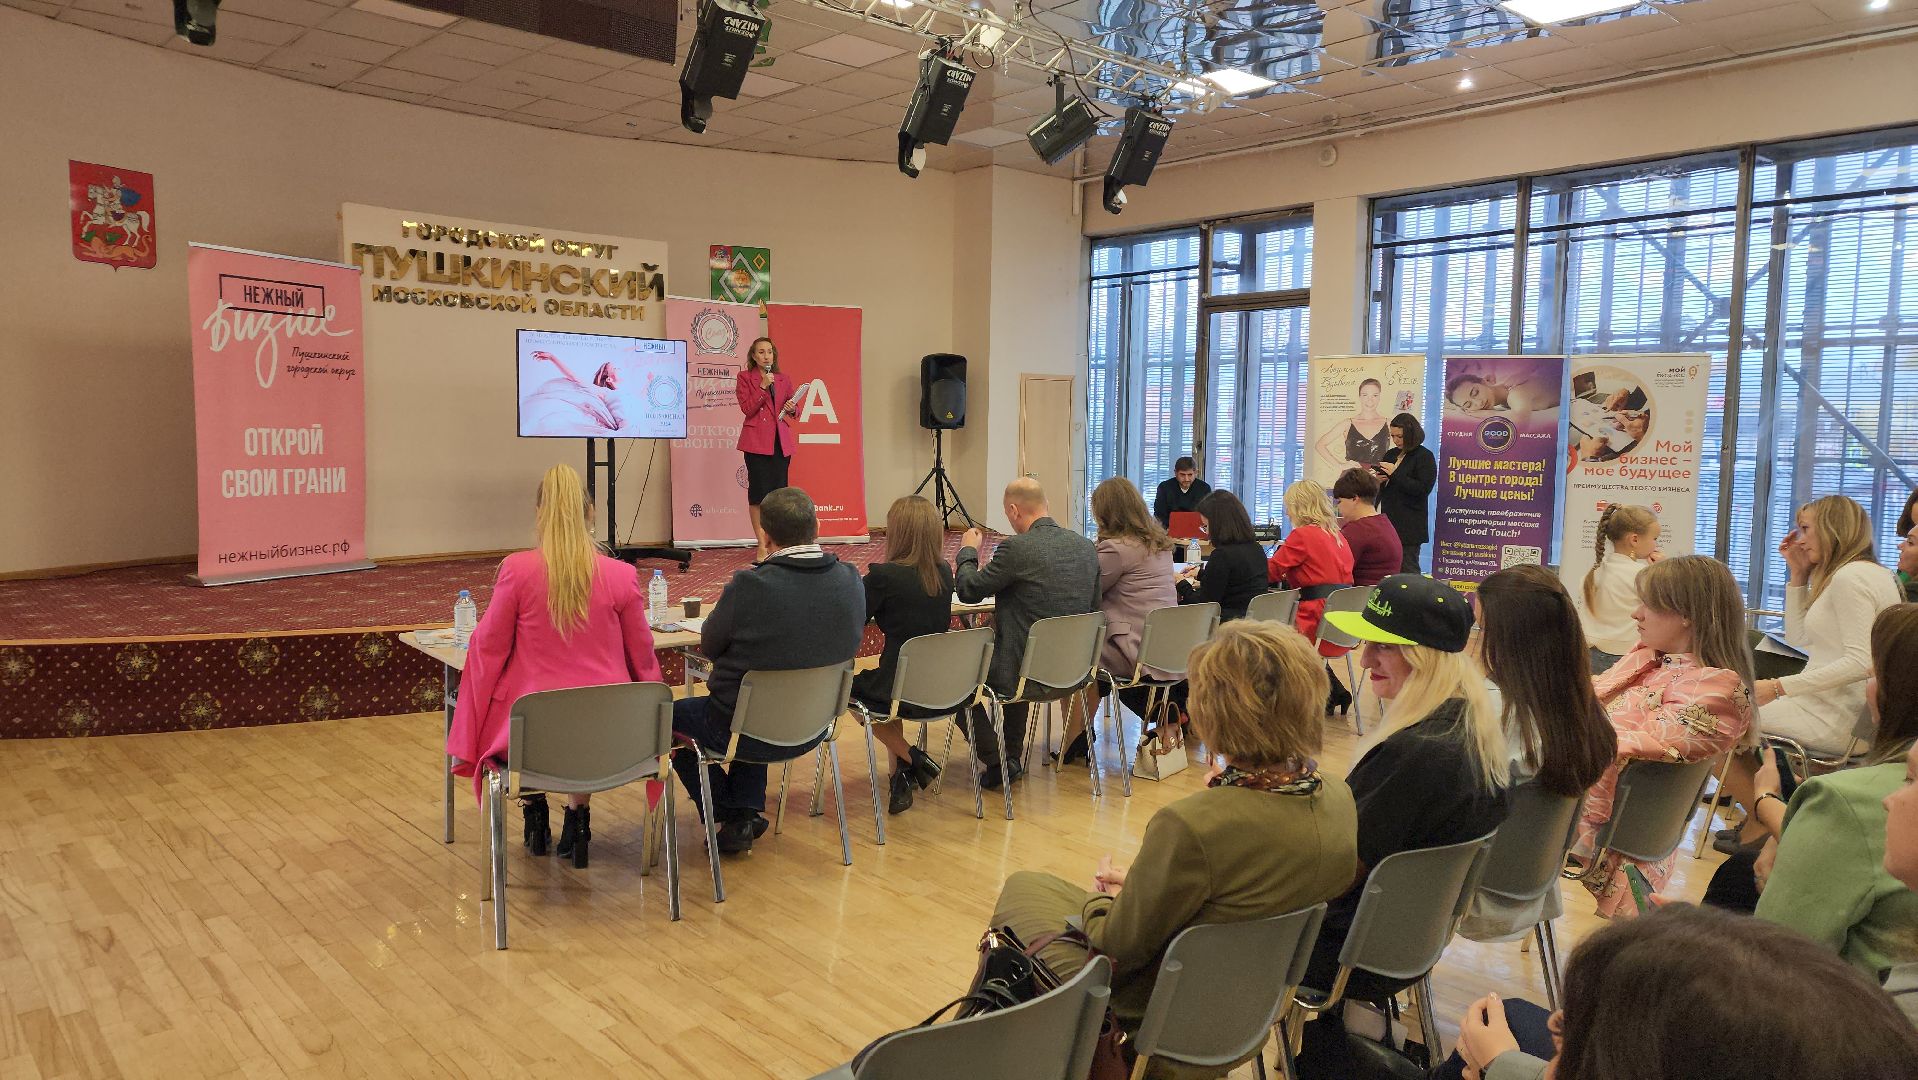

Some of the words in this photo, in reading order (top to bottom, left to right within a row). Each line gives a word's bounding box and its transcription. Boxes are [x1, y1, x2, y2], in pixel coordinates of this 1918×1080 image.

[402, 220, 546, 253] ГОРОДСКОЙ
[552, 239, 619, 260] ОКРУГ
[352, 242, 666, 302] ПУШКИНСКИЙ
[243, 284, 304, 309] НЕЖНЫЙ
[372, 284, 537, 314] МОСКОВСКОЙ
[544, 298, 646, 322] ОБЛАСТИ
[292, 346, 350, 363] Пушкинский
[286, 364, 329, 379] городской
[330, 368, 356, 381] округ
[697, 367, 730, 377] НЕЖНЫЙ
[244, 423, 324, 457] ОТКРОЙ
[1655, 440, 1693, 453] Мой
[1448, 456, 1492, 471] Лучшие
[1494, 459, 1546, 473] мастера!
[1619, 454, 1678, 465] бизнес
[1449, 471, 1456, 483] В
[1458, 474, 1497, 486] центре
[1499, 474, 1543, 486] города!
[1584, 467, 1615, 476] мое
[1619, 466, 1692, 480] будущее
[221, 468, 278, 499] СВОИ
[283, 466, 346, 495] ГРАНИ
[1573, 483, 1629, 491] ПРЕИМУЩЕСТВА
[1454, 486, 1498, 499] Лучшие
[1500, 489, 1535, 501] цены!
[1445, 507, 1486, 516] Доступное
[1488, 510, 1541, 518] преображение
[1458, 518, 1506, 527] территории
[1464, 528, 1488, 536] Good
[1490, 528, 1521, 538] Touch!
[218, 539, 350, 564] нежныйбизнес.рф
